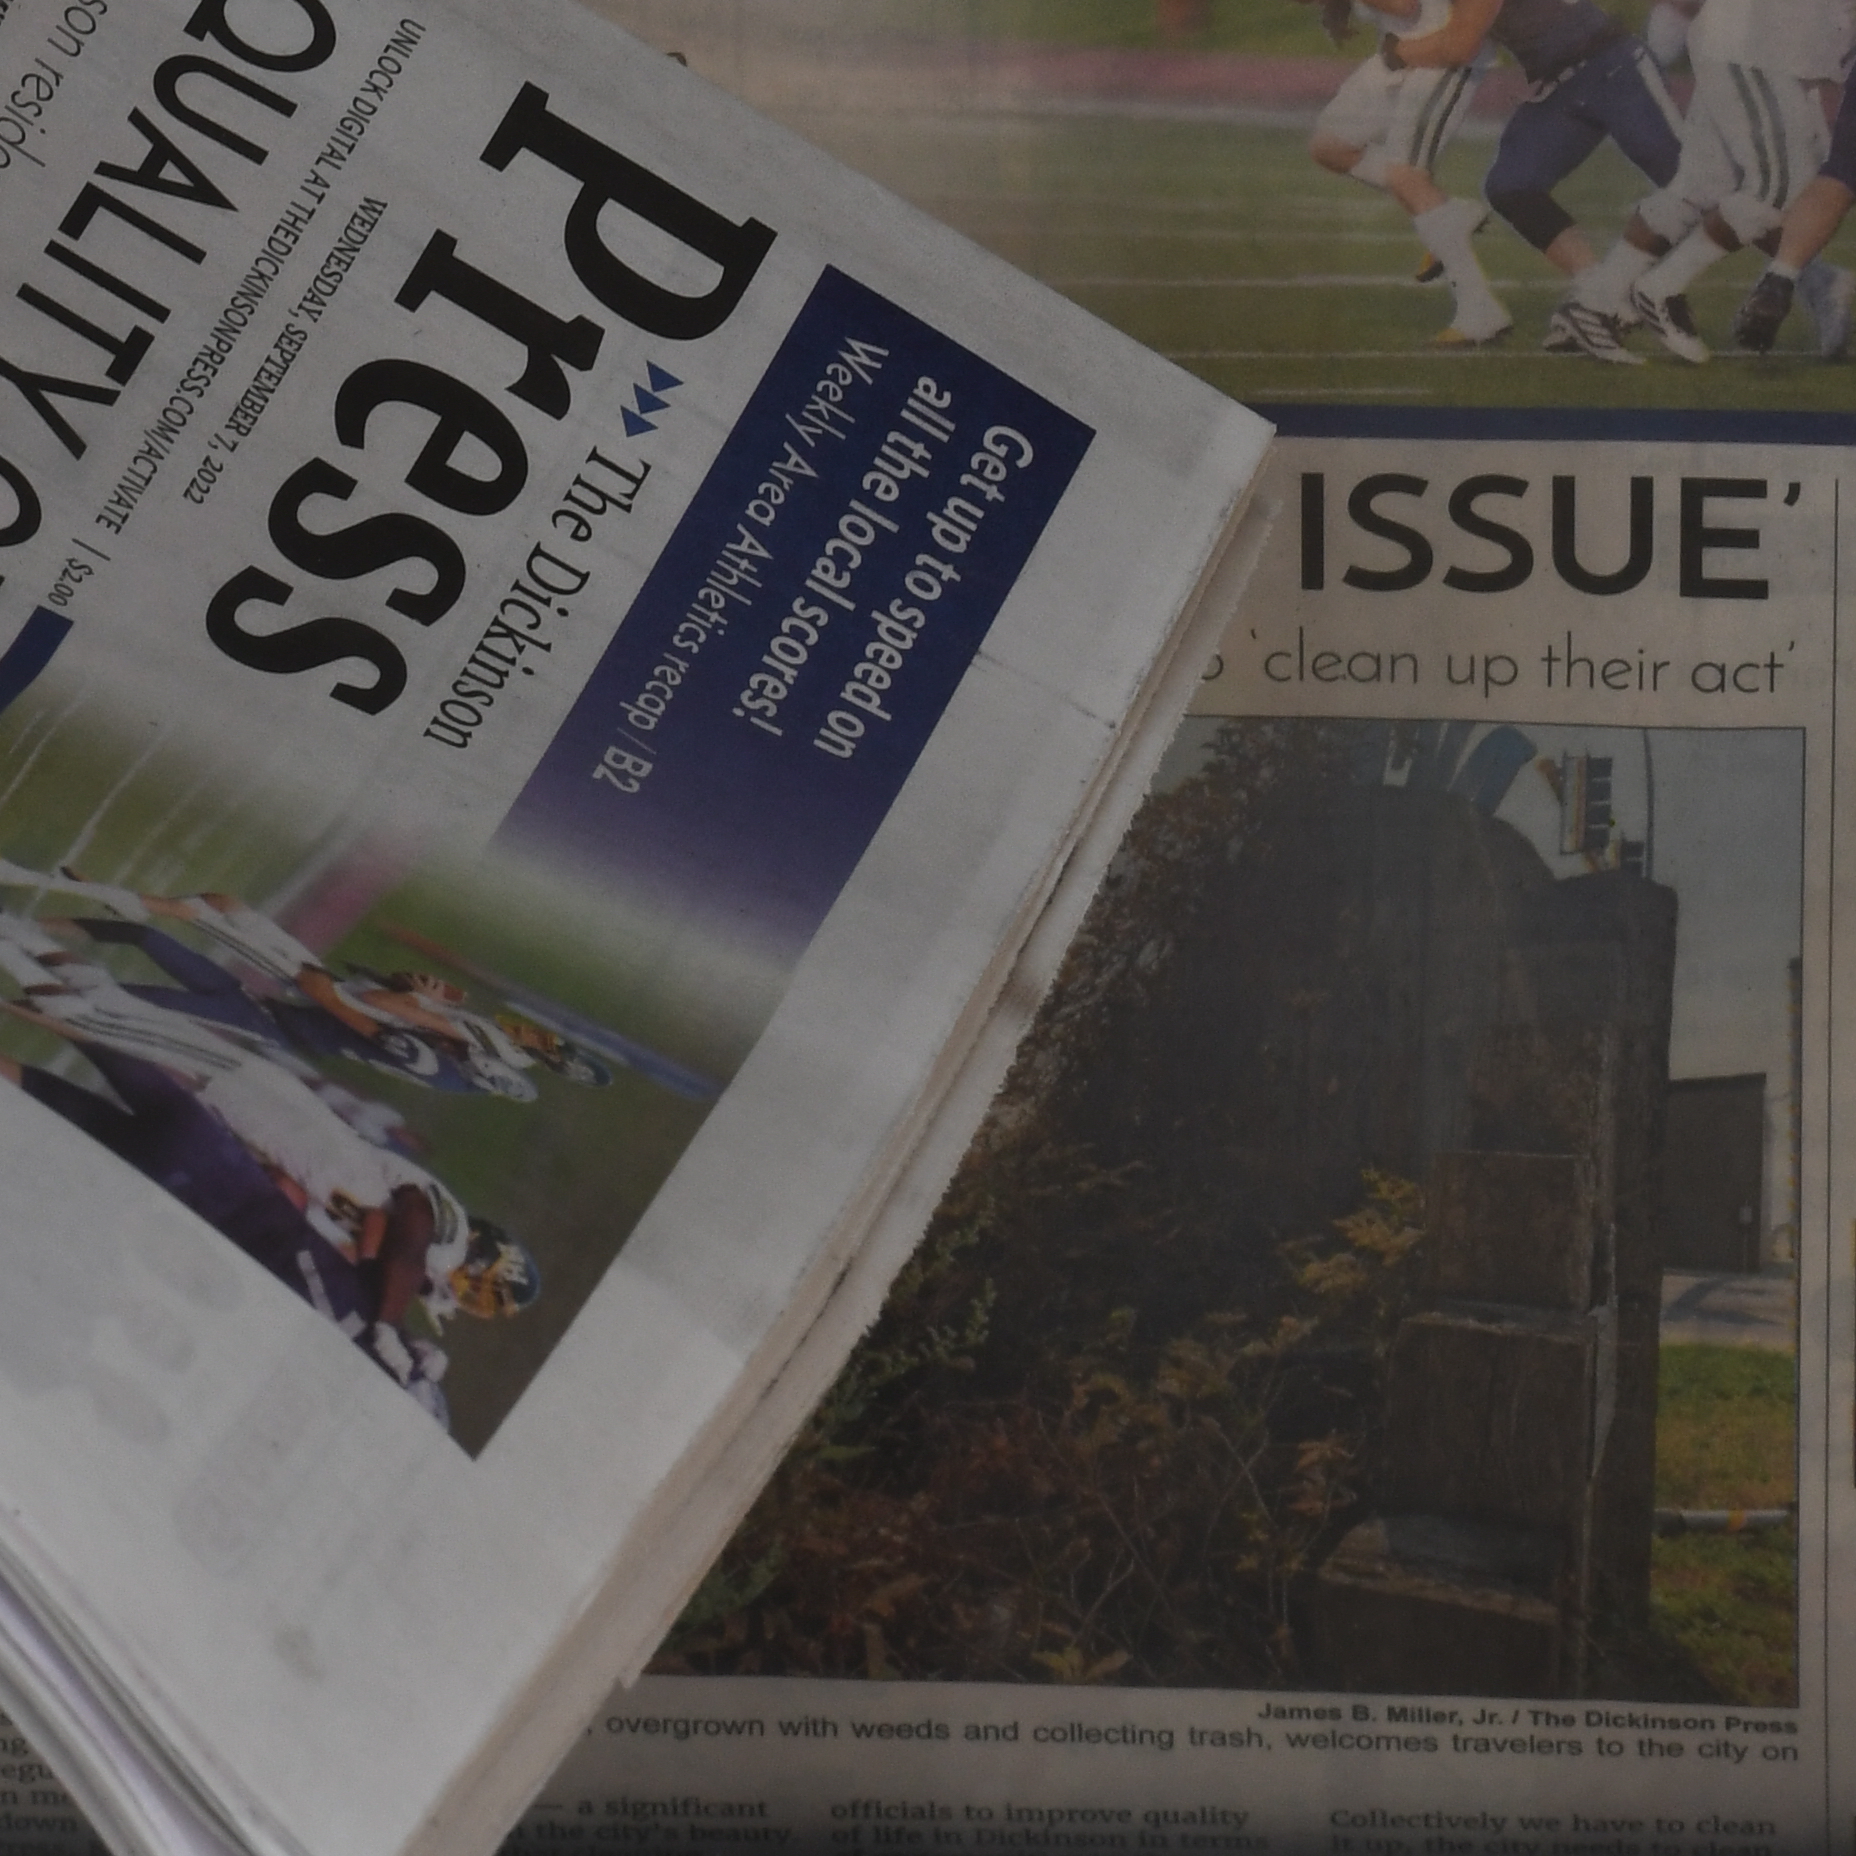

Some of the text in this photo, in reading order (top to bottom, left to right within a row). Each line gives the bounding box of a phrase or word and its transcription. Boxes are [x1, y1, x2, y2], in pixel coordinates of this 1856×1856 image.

[94, 17, 426, 535] UNLOCK DIGITAL AT THEDICKINSONPRESS.COM/ACTIVATE
[181, 195, 388, 504] WEDNESDAY, SEPTEMBER 7, 2022
[204, 80, 778, 716] Press
[783, 335, 890, 448] Weekly
[743, 440, 819, 527] Area
[46, 556, 95, 607] $2.00
[422, 444, 652, 749] The Dickinson
[671, 521, 774, 654] Athletics
[731, 375, 956, 736] all the local scores!
[812, 424, 1034, 758] Get up to speed on
[618, 651, 690, 731] recap
[1445, 653, 1519, 699] up
[1539, 629, 1671, 692] their
[590, 744, 654, 793] B2
[605, 1714, 1799, 1765] overgrown with weeds and collecting trash, welcomes travelers to the city on
